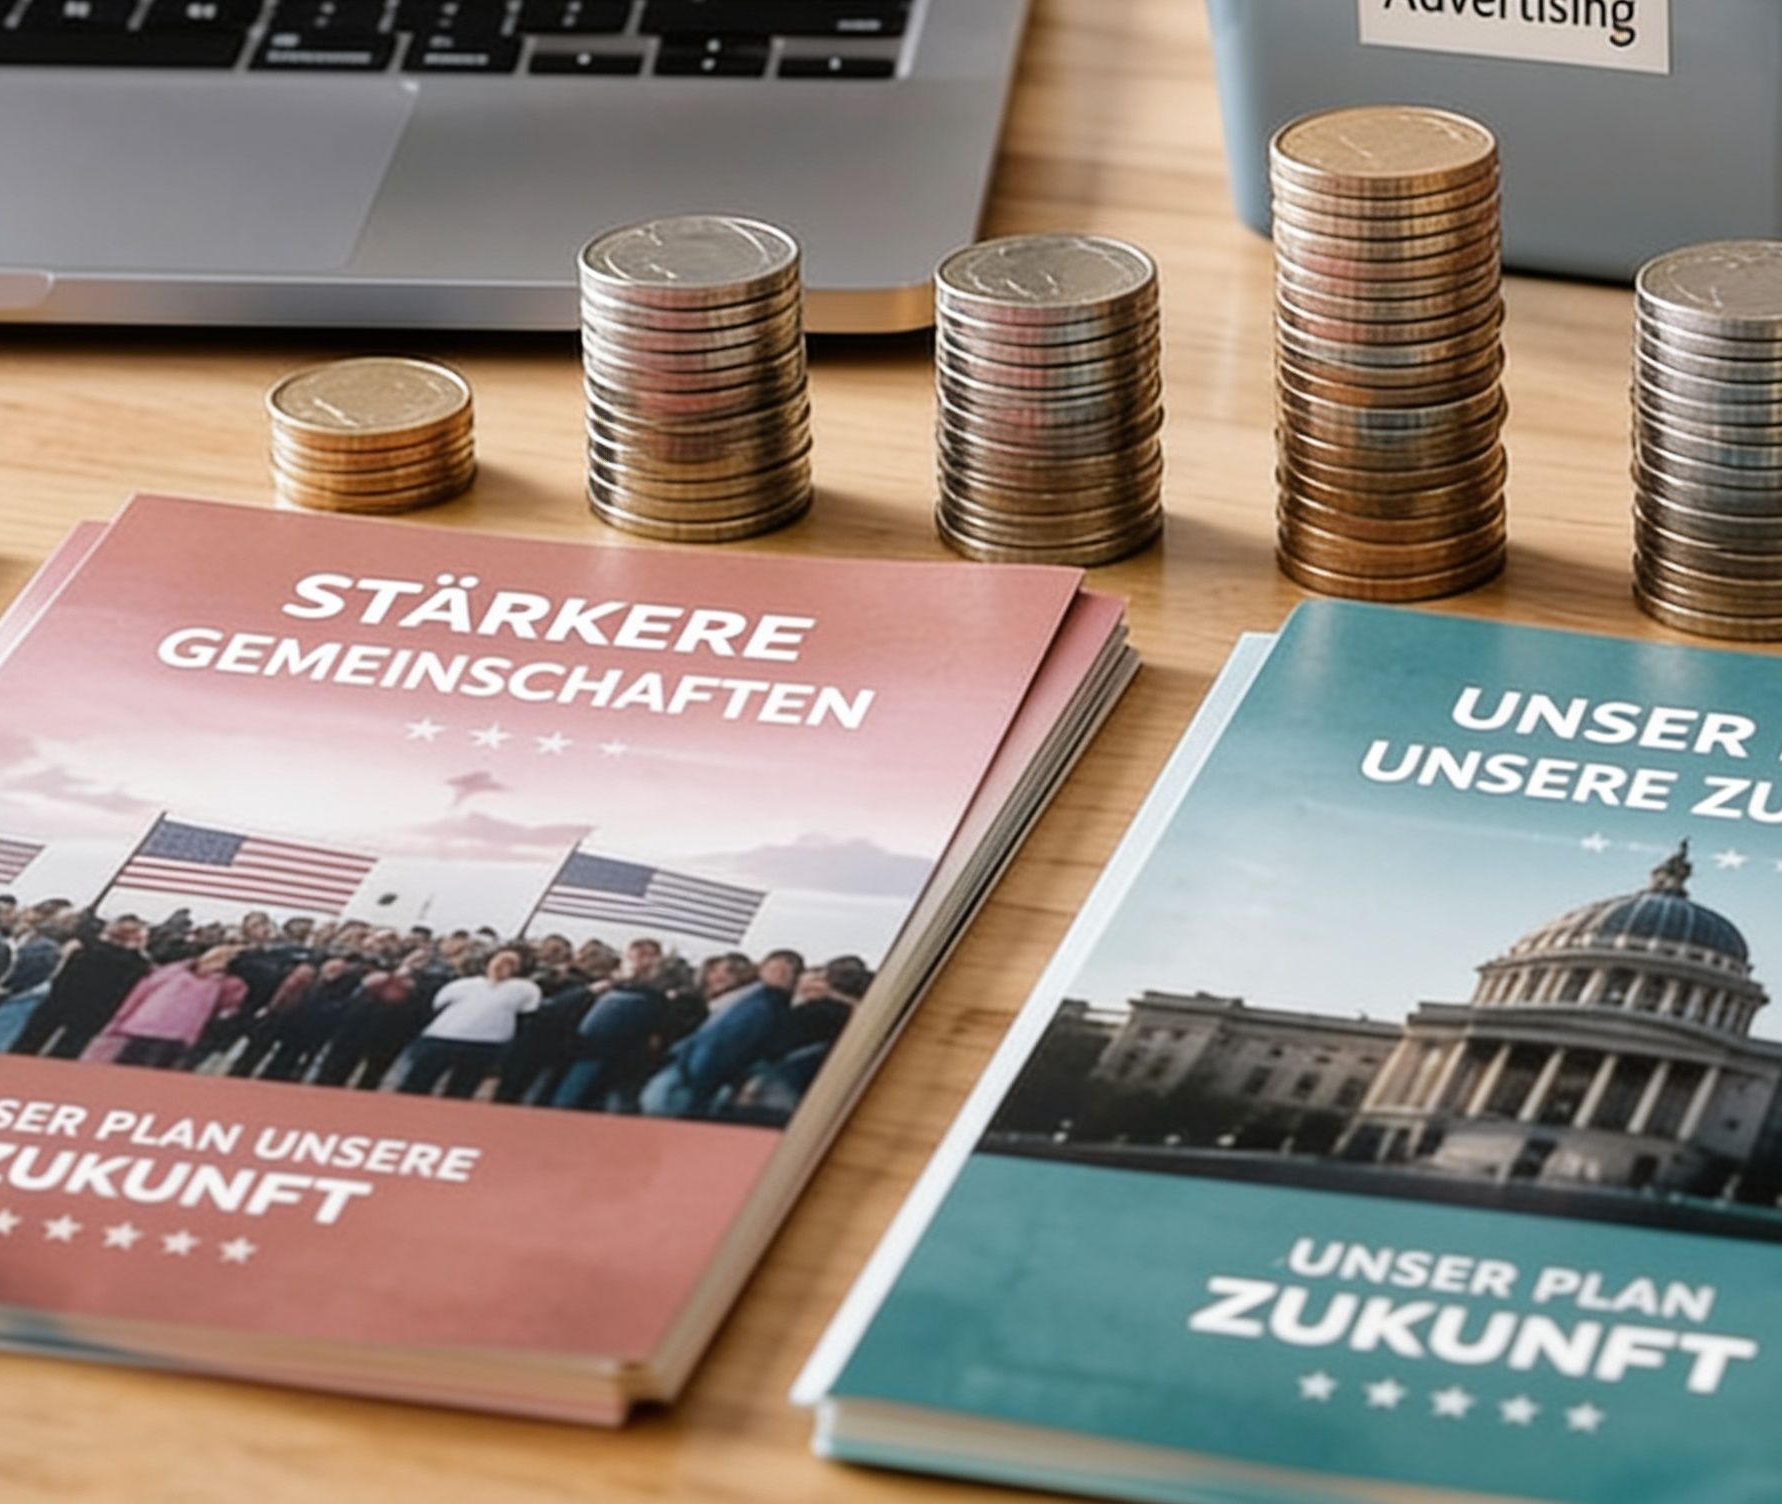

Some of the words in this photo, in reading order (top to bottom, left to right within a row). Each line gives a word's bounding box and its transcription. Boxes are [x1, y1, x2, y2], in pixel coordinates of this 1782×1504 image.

[281, 572, 816, 663] STÄRKERE
[156, 627, 876, 730] GEMEINSCHAFTEN
[1450, 686, 1757, 759] UNSER
[1359, 739, 1679, 812] UNSERE
[95, 1109, 245, 1156] PLAN
[254, 1126, 481, 1183] UNSERE
[1286, 1237, 1519, 1298] UNSER
[1532, 1266, 1718, 1322] PLAN
[1188, 1276, 1759, 1394] ZUKUNFT
